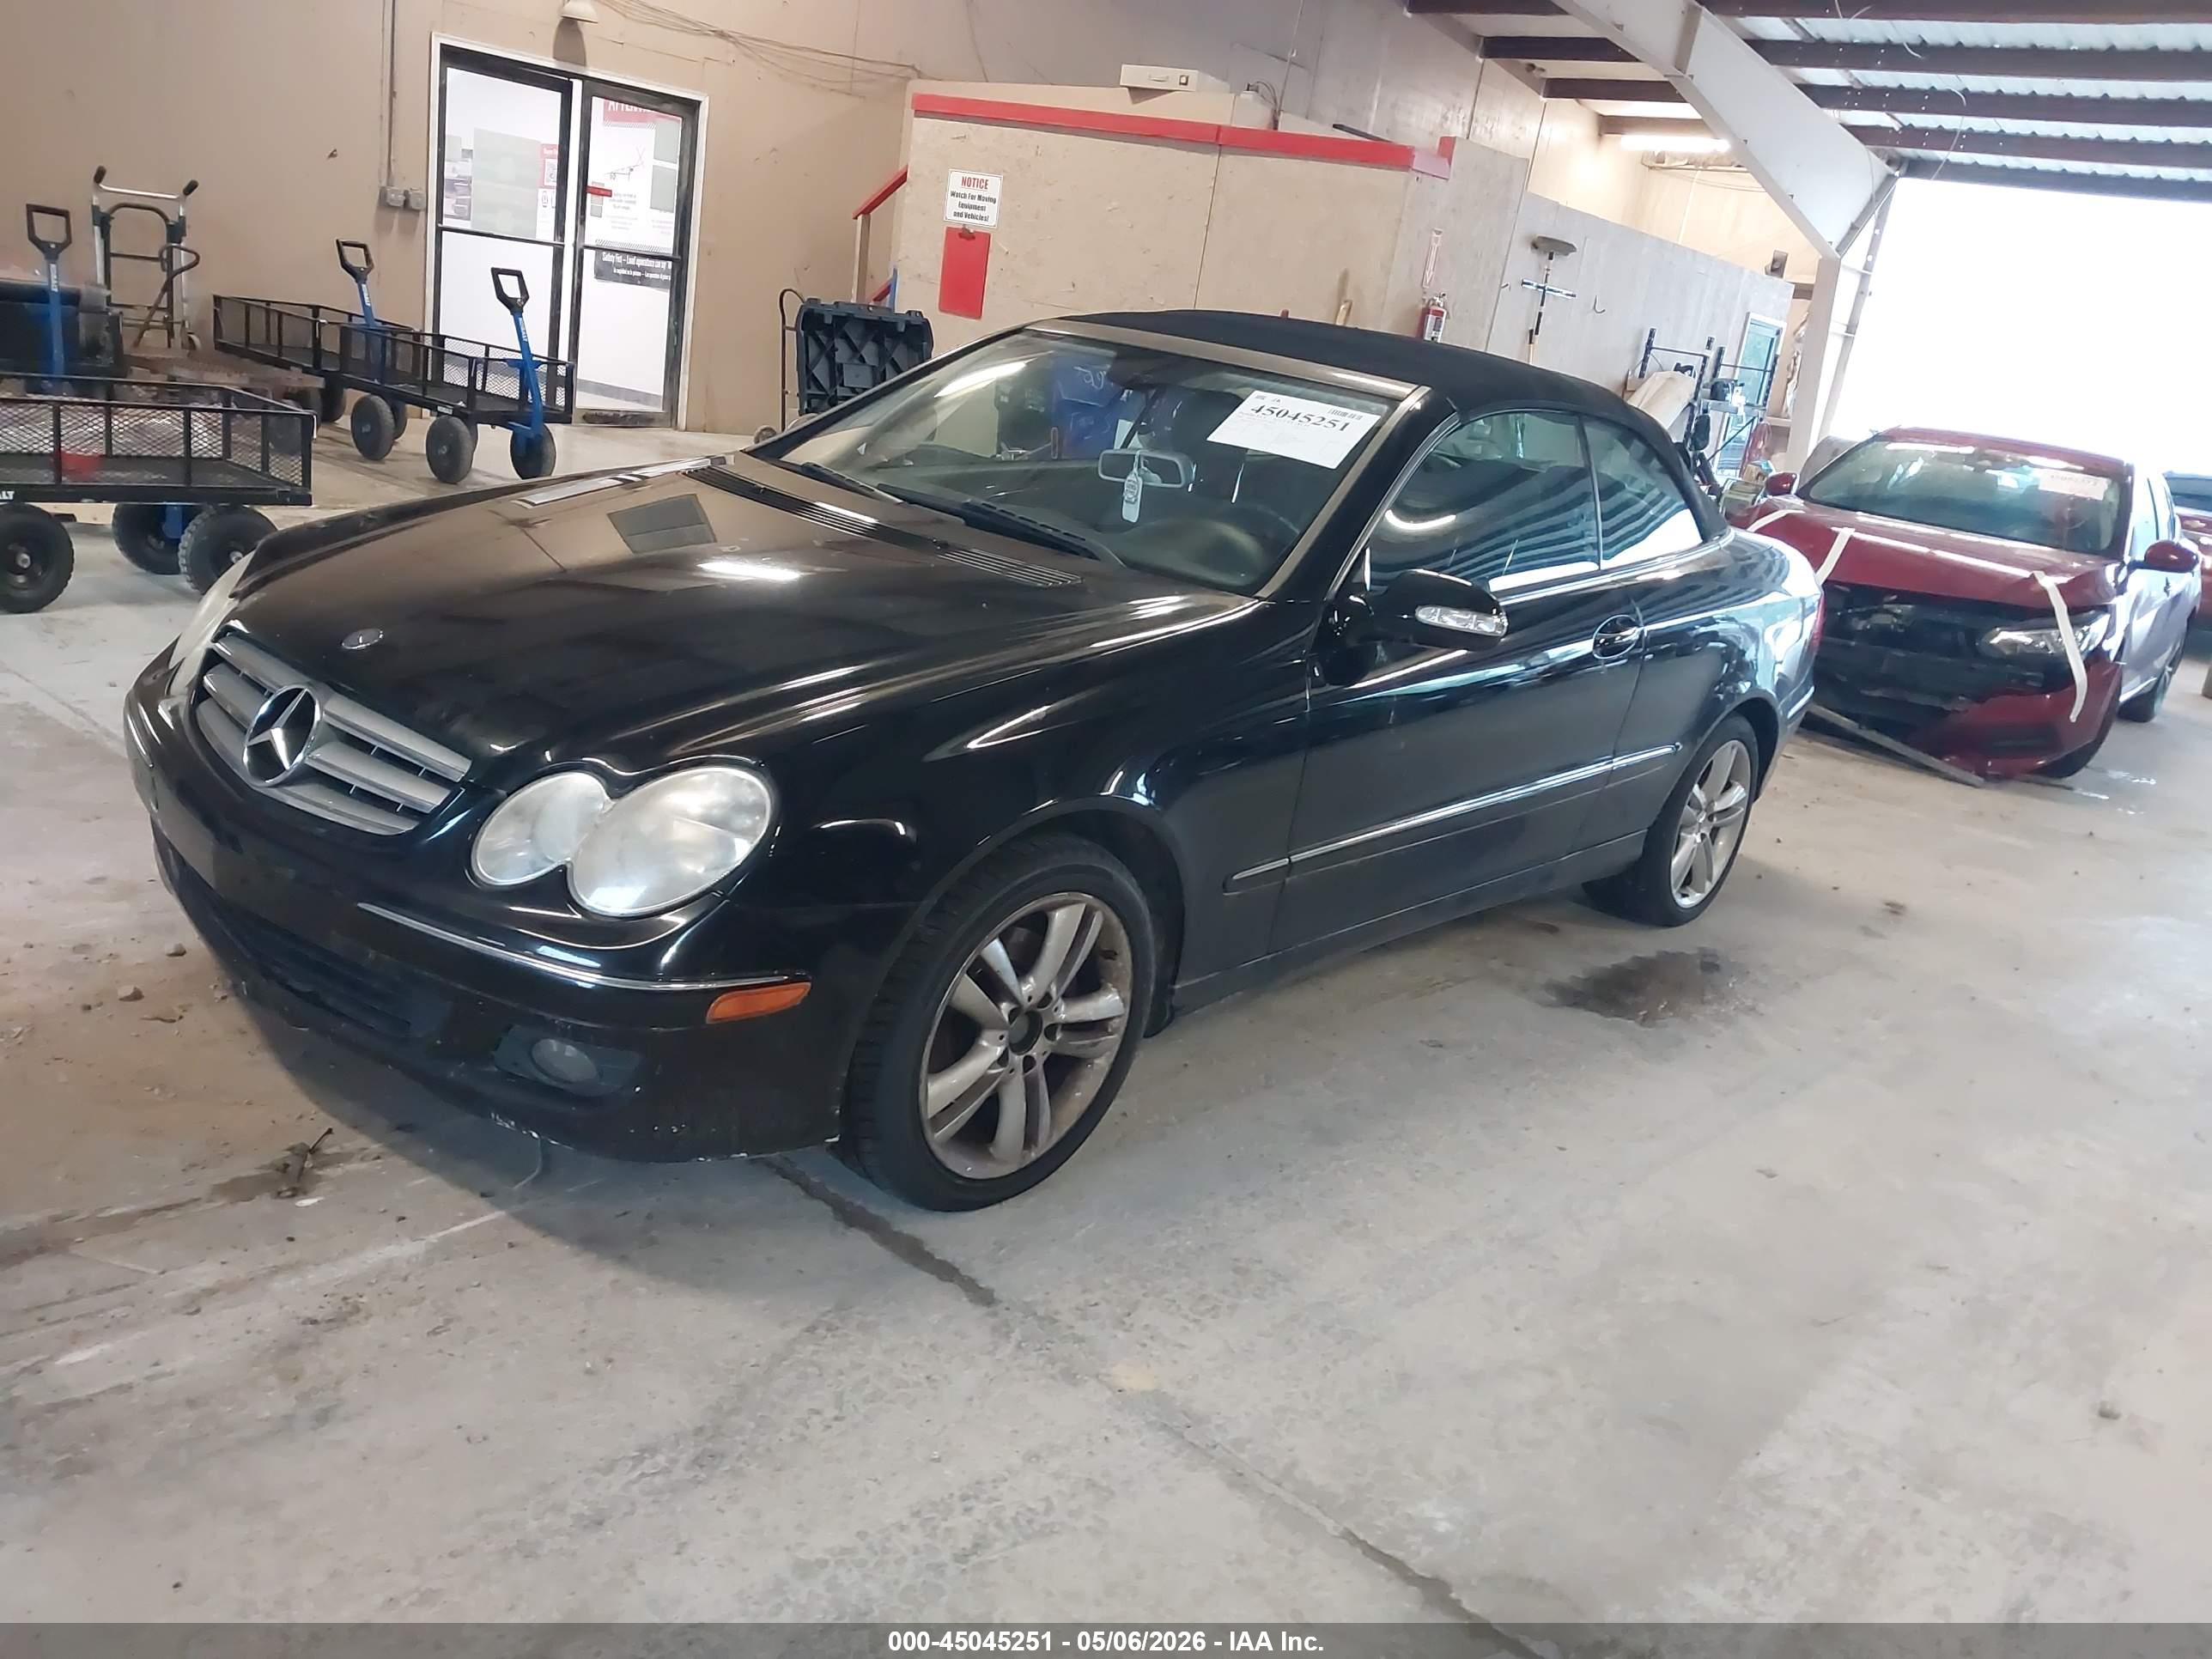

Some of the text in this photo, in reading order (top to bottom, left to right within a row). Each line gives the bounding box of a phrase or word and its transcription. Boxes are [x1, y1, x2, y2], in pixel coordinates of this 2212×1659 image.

[961, 176, 989, 190] NOTICE
[950, 191, 997, 204] Watch For Moving
[957, 201, 987, 212] Equipment
[963, 211, 989, 222] Vehicles!
[1250, 404, 1351, 431] 45045251
[0, 490, 15, 500] LT
